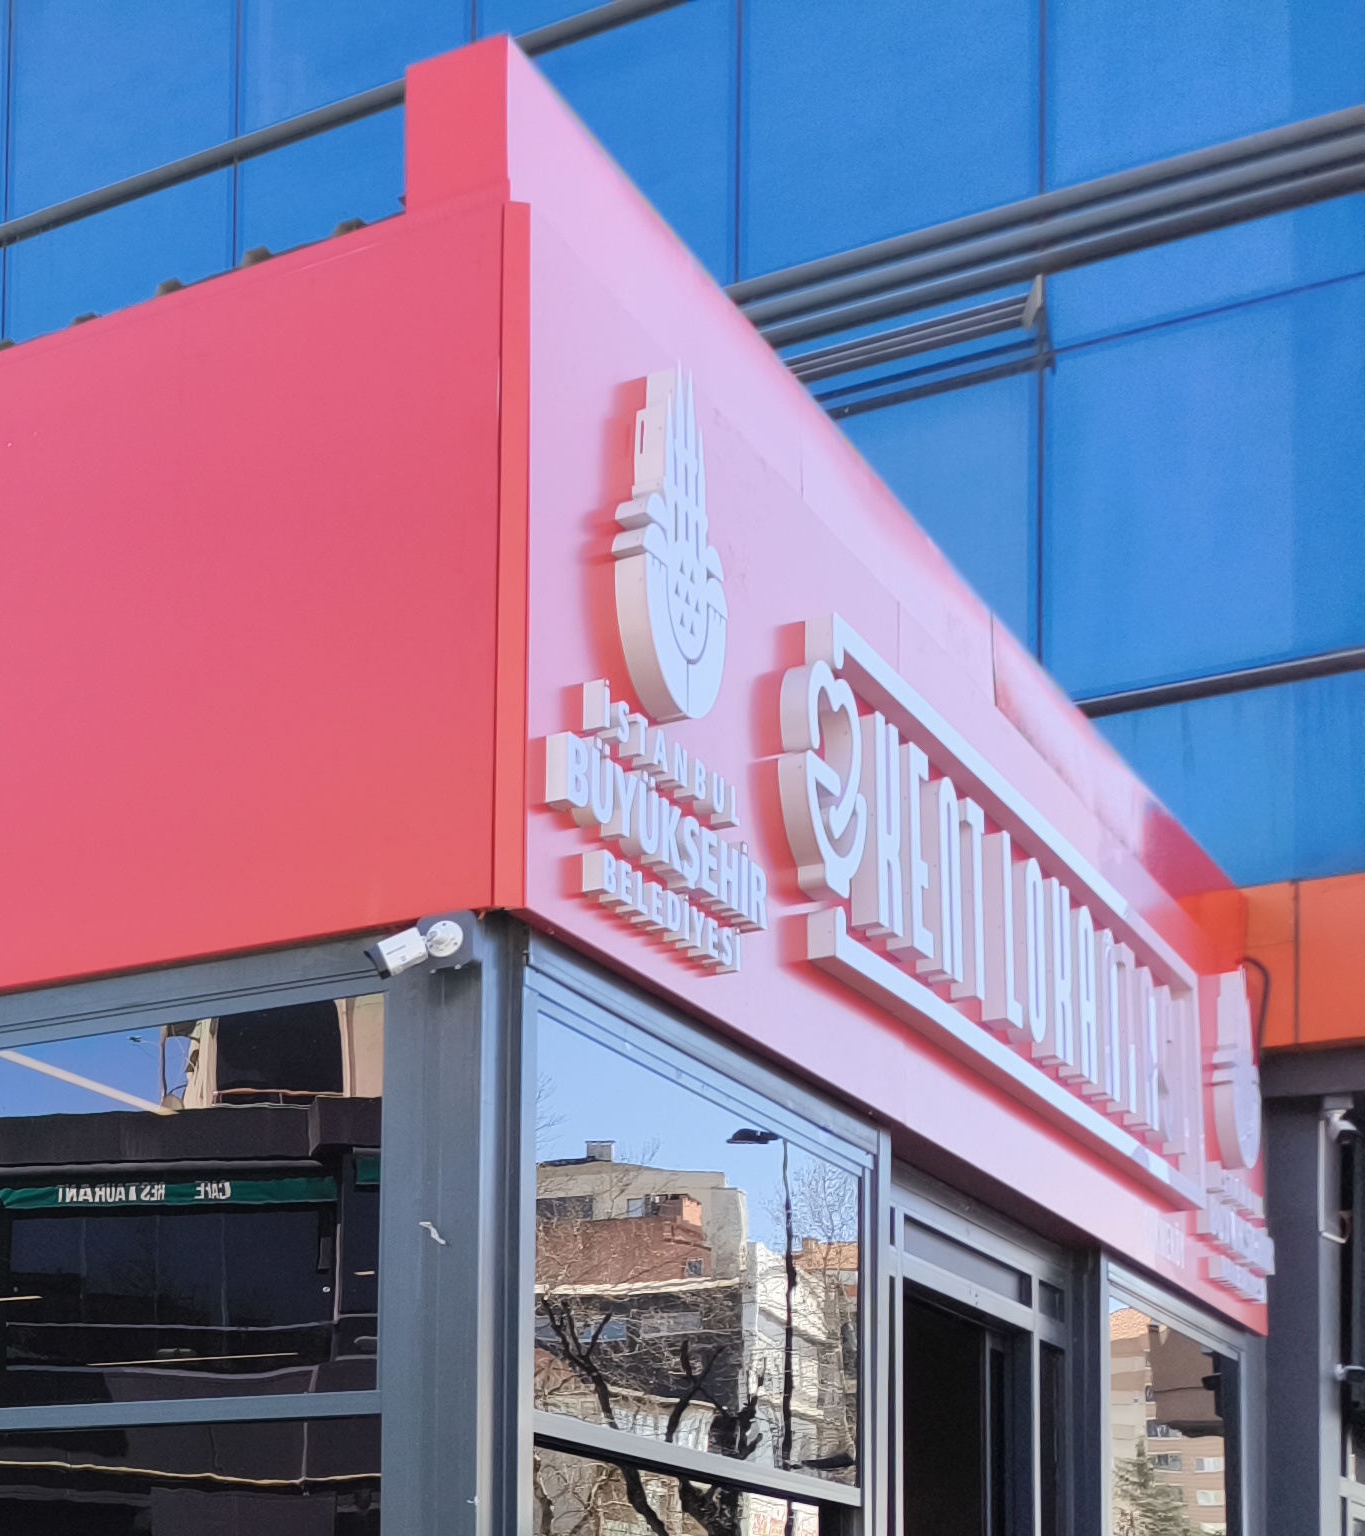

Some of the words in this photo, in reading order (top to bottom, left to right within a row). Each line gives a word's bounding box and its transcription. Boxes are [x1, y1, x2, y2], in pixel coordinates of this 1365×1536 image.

[546, 731, 767, 932] BÜYÜKŞEHİR
[583, 677, 740, 828] İSTANBUL
[582, 848, 741, 975] BELEDİYESİ
[852, 711, 985, 1001] KENT
